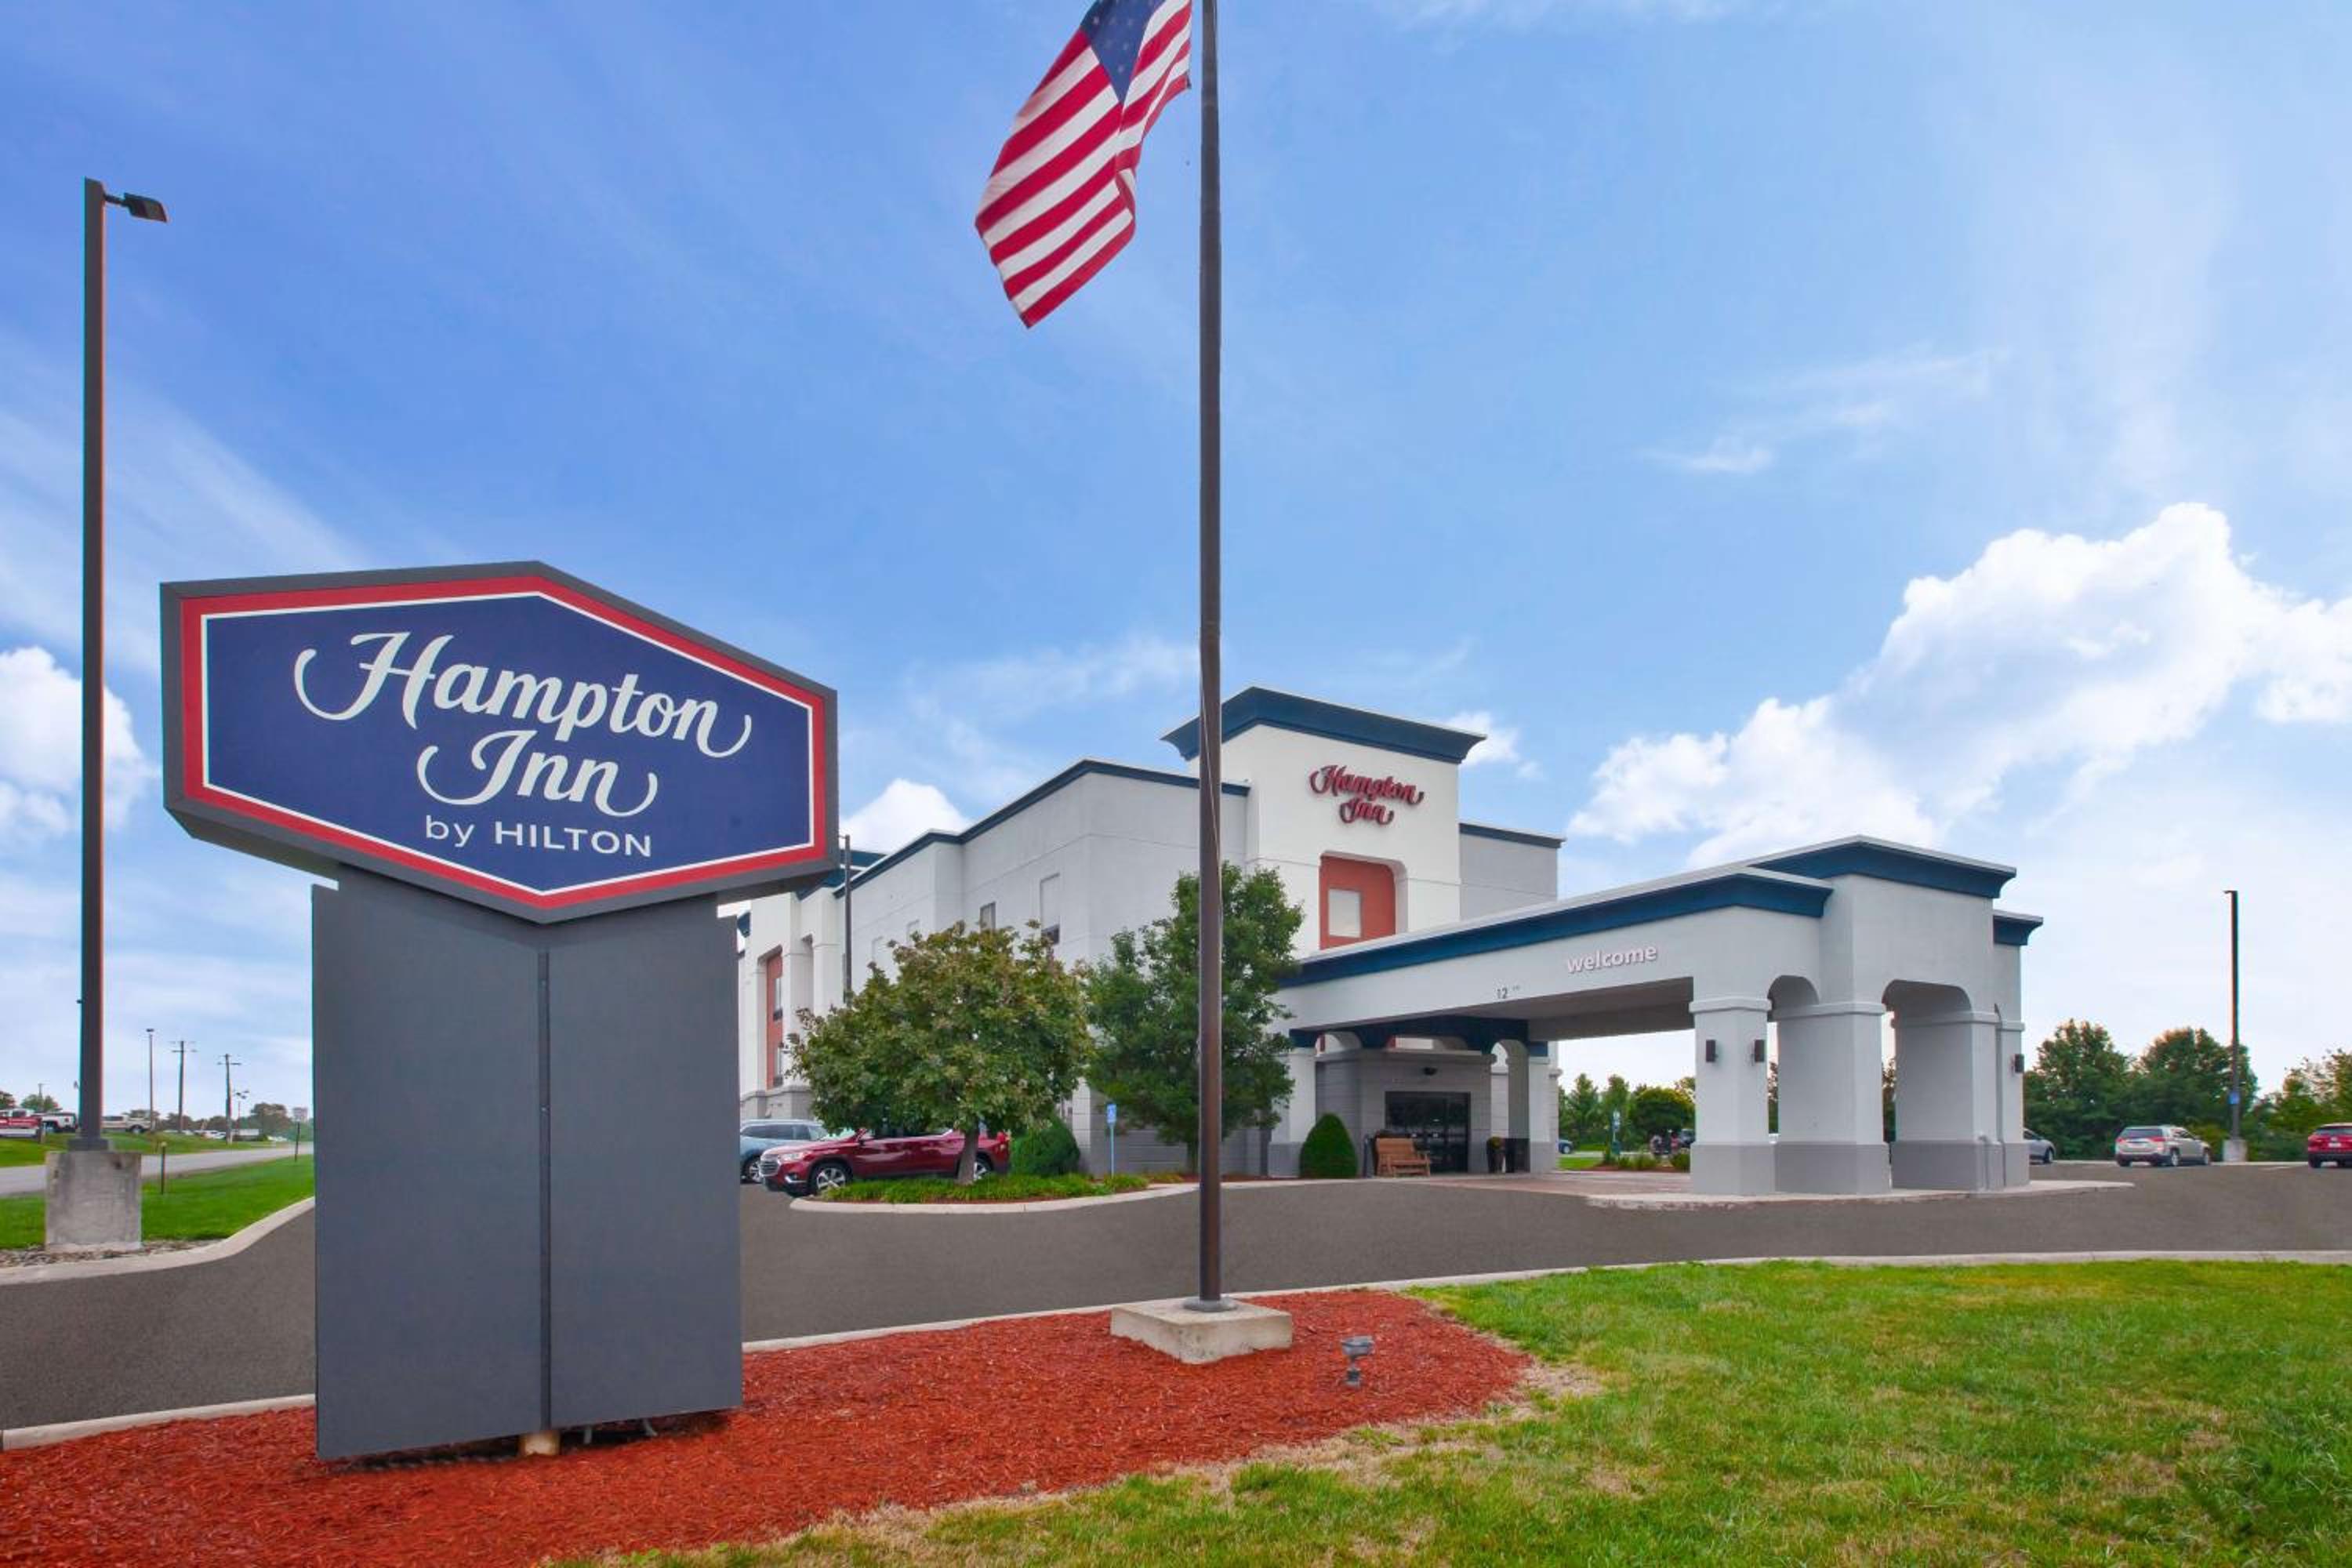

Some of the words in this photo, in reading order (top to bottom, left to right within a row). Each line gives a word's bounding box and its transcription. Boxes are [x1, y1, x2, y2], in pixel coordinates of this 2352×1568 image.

[294, 631, 752, 758] Hampton
[416, 730, 659, 817] Inn
[1308, 764, 1425, 805] Hampton
[1339, 798, 1394, 825] Inn
[425, 815, 475, 848] by
[495, 821, 652, 858] HILTON
[1567, 946, 1657, 973] welcome
